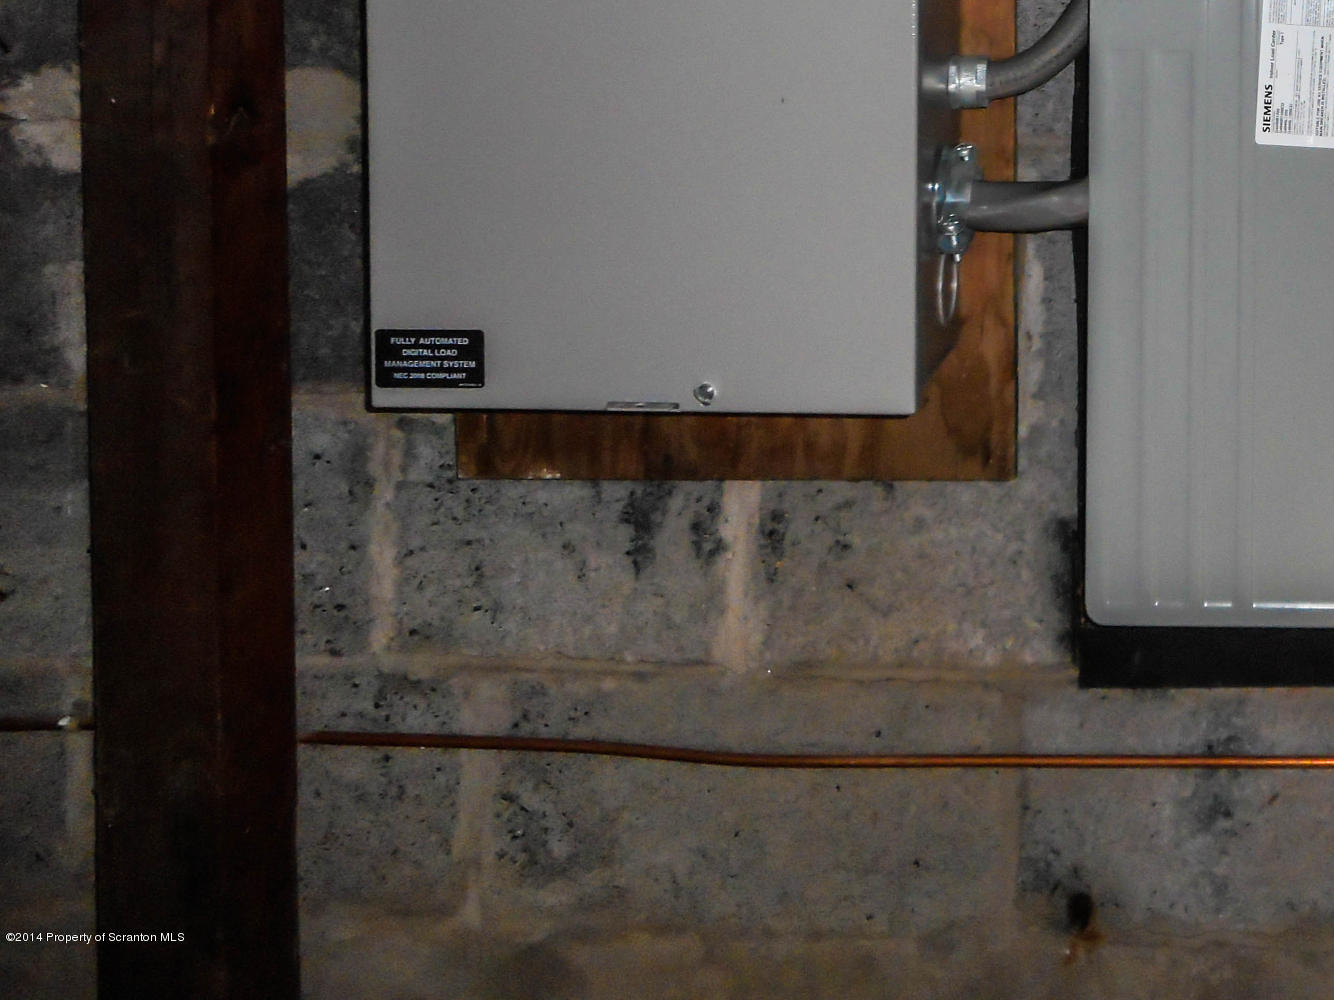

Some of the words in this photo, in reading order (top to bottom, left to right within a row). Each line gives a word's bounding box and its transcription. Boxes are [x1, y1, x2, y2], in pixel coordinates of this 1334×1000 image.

[1262, 83, 1273, 133] SIEMENS
[390, 337, 416, 345] FULLY
[419, 337, 469, 345] AUTOMATED
[402, 348, 433, 356] DIGITAL
[384, 360, 441, 368] MANAGEMENT
[443, 360, 476, 368] SYSTEM
